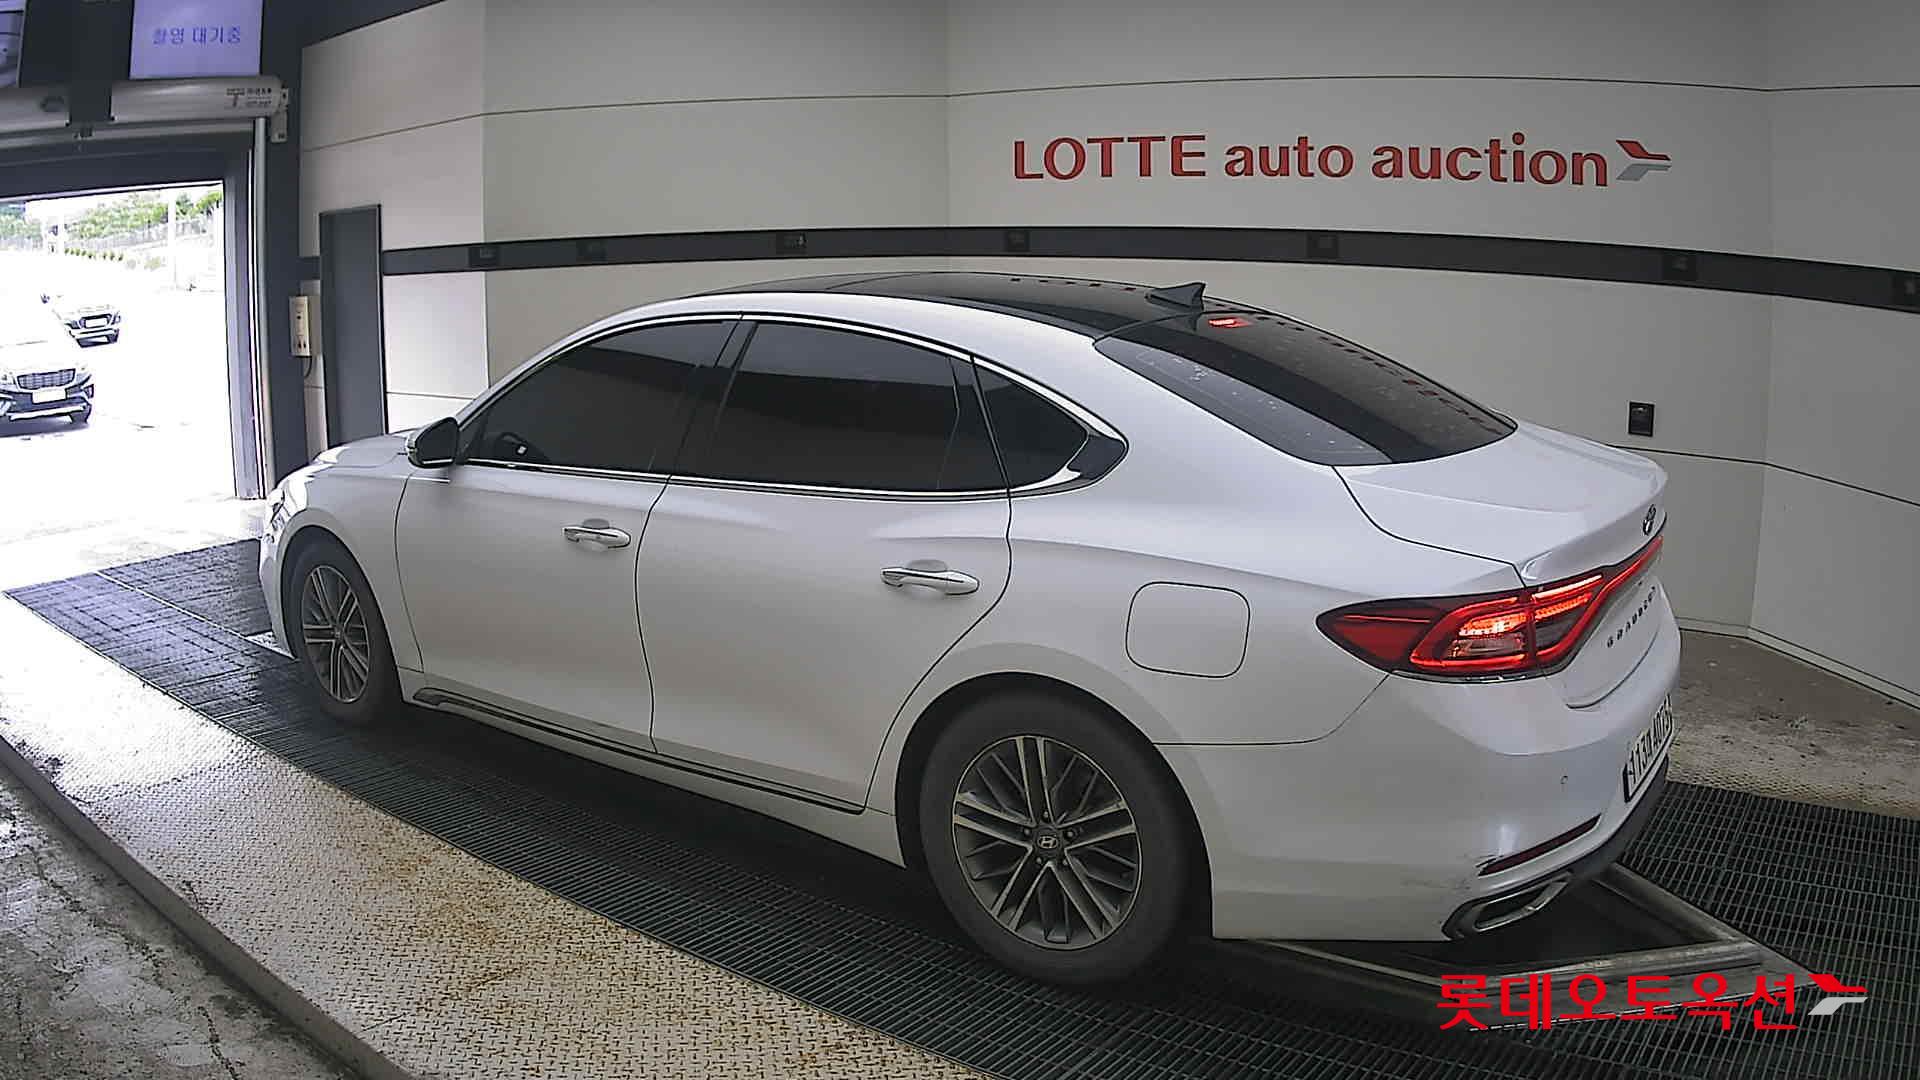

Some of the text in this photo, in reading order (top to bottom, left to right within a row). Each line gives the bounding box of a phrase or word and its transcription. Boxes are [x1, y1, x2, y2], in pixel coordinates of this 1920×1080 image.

[192, 25, 241, 45] 대기중
[1014, 132, 1608, 188] LOTTE auto auction
